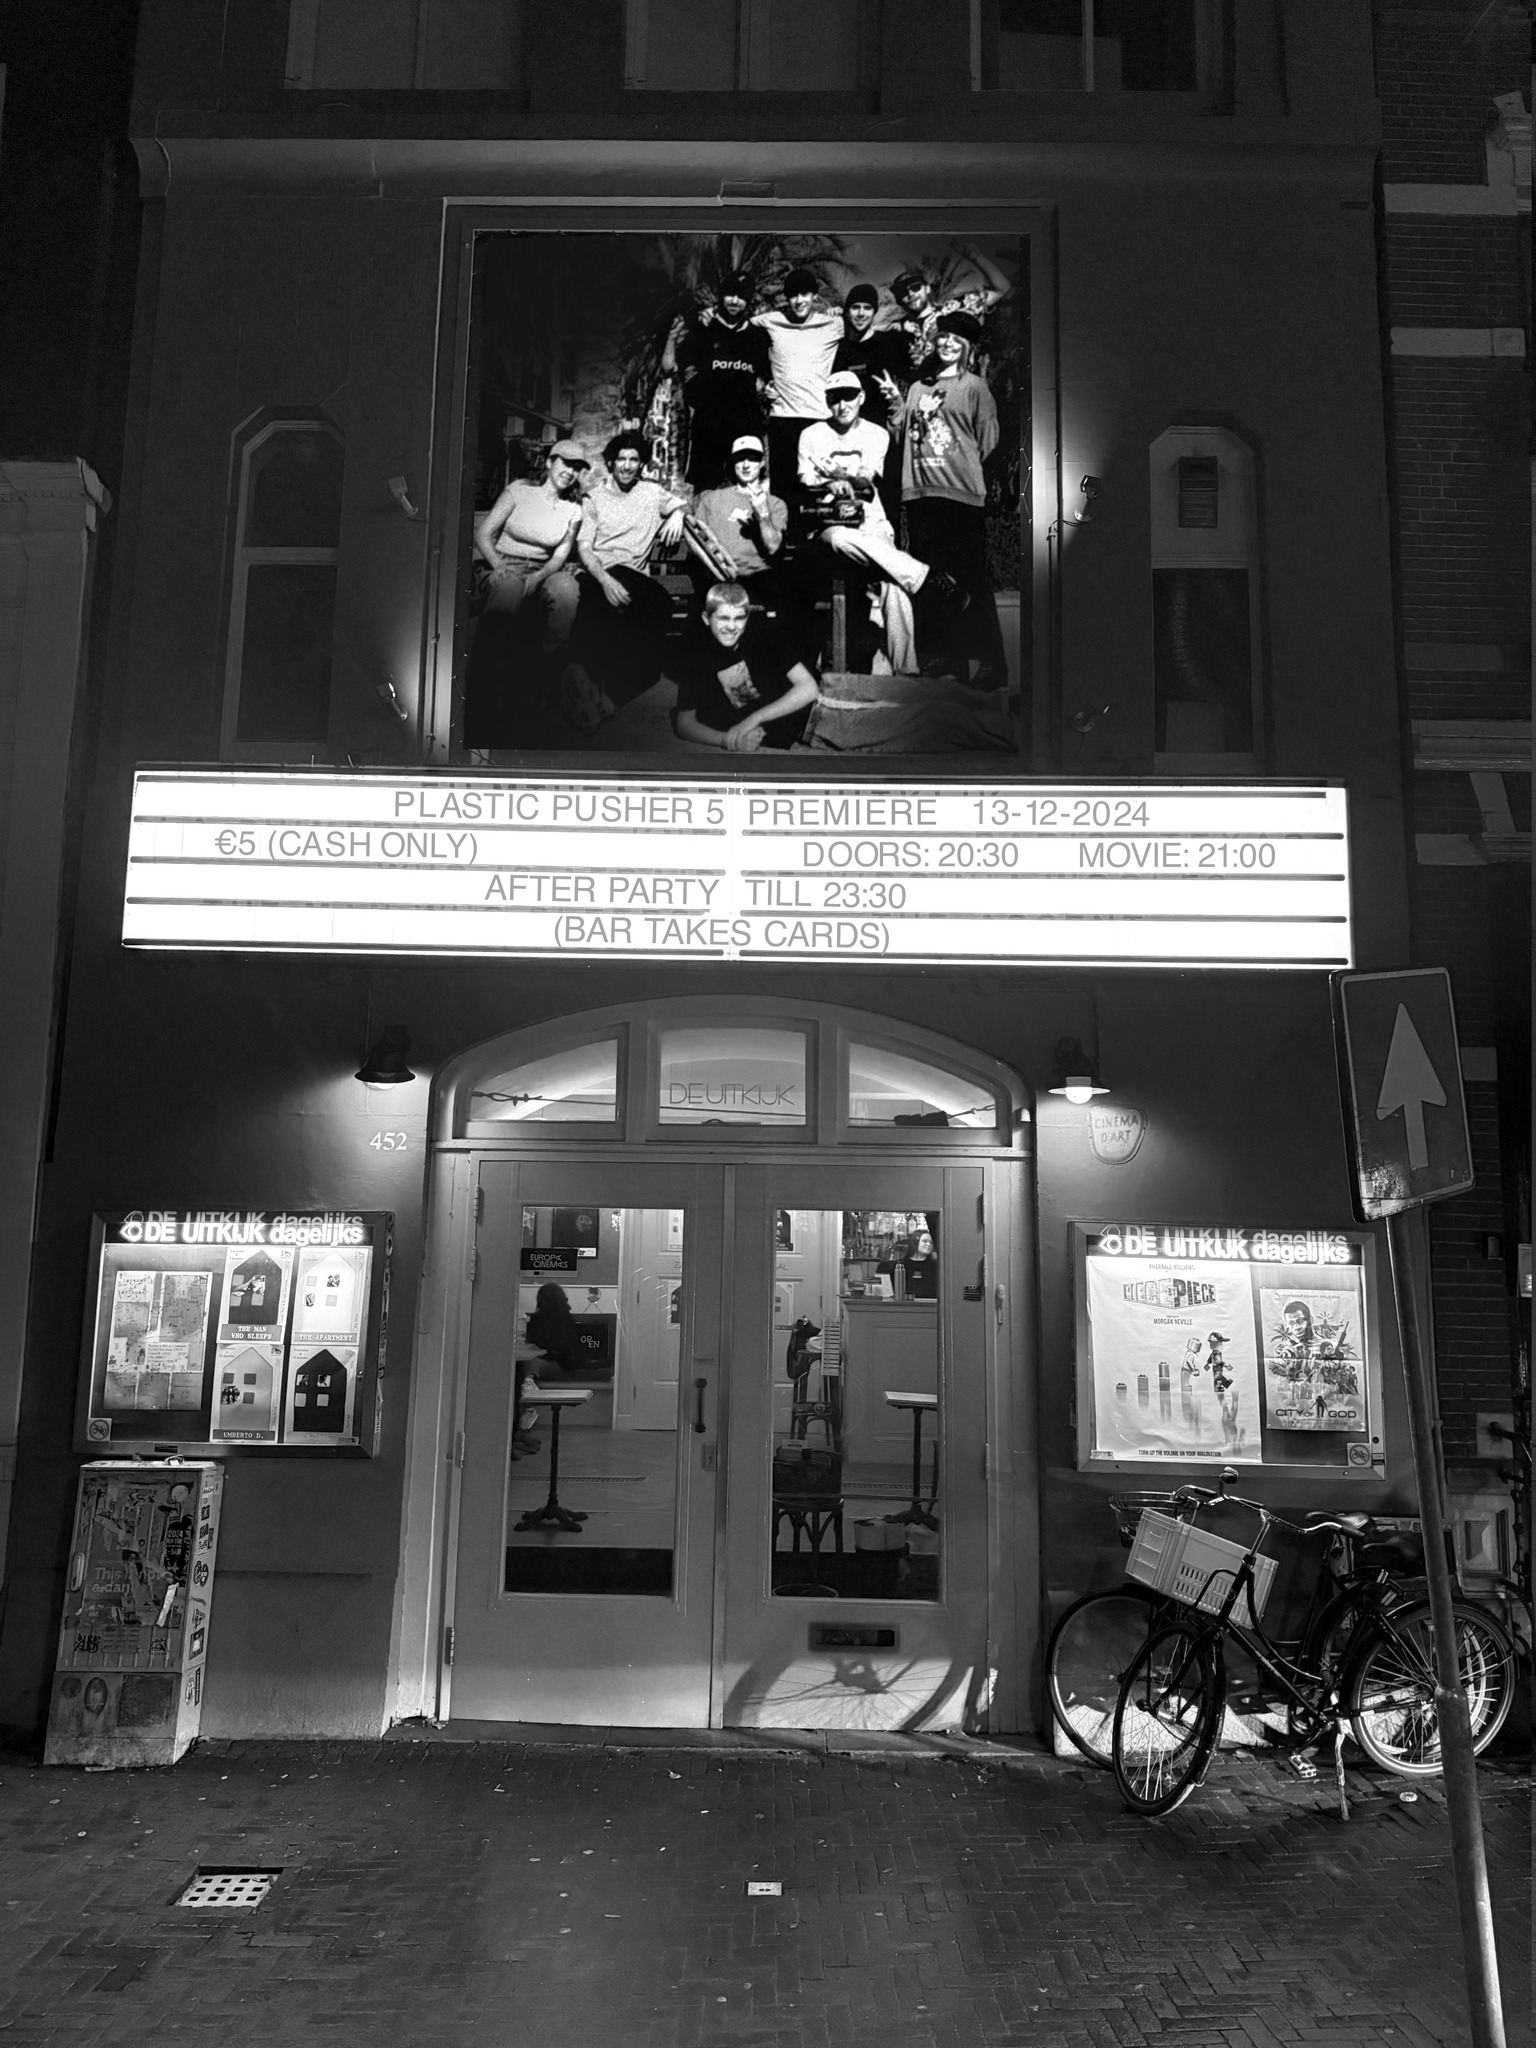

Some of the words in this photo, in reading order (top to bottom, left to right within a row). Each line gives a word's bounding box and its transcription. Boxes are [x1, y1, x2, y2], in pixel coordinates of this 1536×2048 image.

[394, 791, 539, 820] PLASTIC
[552, 794, 693, 824] PUSHER
[706, 798, 724, 825] 5
[749, 798, 937, 826] PREMIERE
[973, 799, 1150, 827] 13-12-2024
[214, 829, 256, 856] €5
[268, 829, 371, 862] (CASH
[380, 831, 479, 864] ONLY)
[803, 841, 929, 868] DOORS:
[938, 842, 1019, 868] 20:30
[1079, 842, 1189, 868] MOVIE:
[1198, 843, 1276, 869] 21:00
[484, 874, 596, 902] AFTER
[609, 876, 720, 905] PARTY
[744, 878, 812, 907] TILL
[823, 881, 907, 910] 23:30
[554, 914, 632, 949] (BAR
[644, 917, 751, 947] TAKES
[764, 919, 890, 955] CARDS)
[669, 1082, 704, 1105] DE
[706, 1082, 796, 1106] UITKIJK
[1094, 1114, 1139, 1129] CINEMA
[369, 1131, 408, 1151] 452
[1101, 1129, 1132, 1143] D'ART
[144, 1222, 177, 1243] DE
[182, 1222, 266, 1244] UITKIJK
[269, 1223, 364, 1247] dagelijks
[530, 1253, 562, 1262] EUROPA
[1125, 1235, 1158, 1256] DE
[1163, 1236, 1250, 1259] UITKIJK
[1251, 1239, 1351, 1265] dagelijks
[533, 1260, 568, 1269] CINEMAS
[1123, 1278, 1172, 1306] PIECE
[1172, 1278, 1216, 1307] PIECE
[237, 1325, 251, 1333] THE
[1153, 1318, 1174, 1326] MORGAN
[1275, 1408, 1304, 1417] CITY
[1328, 1409, 1357, 1419] GOD
[94, 1566, 122, 1580] This
[104, 1581, 131, 1593] dan
